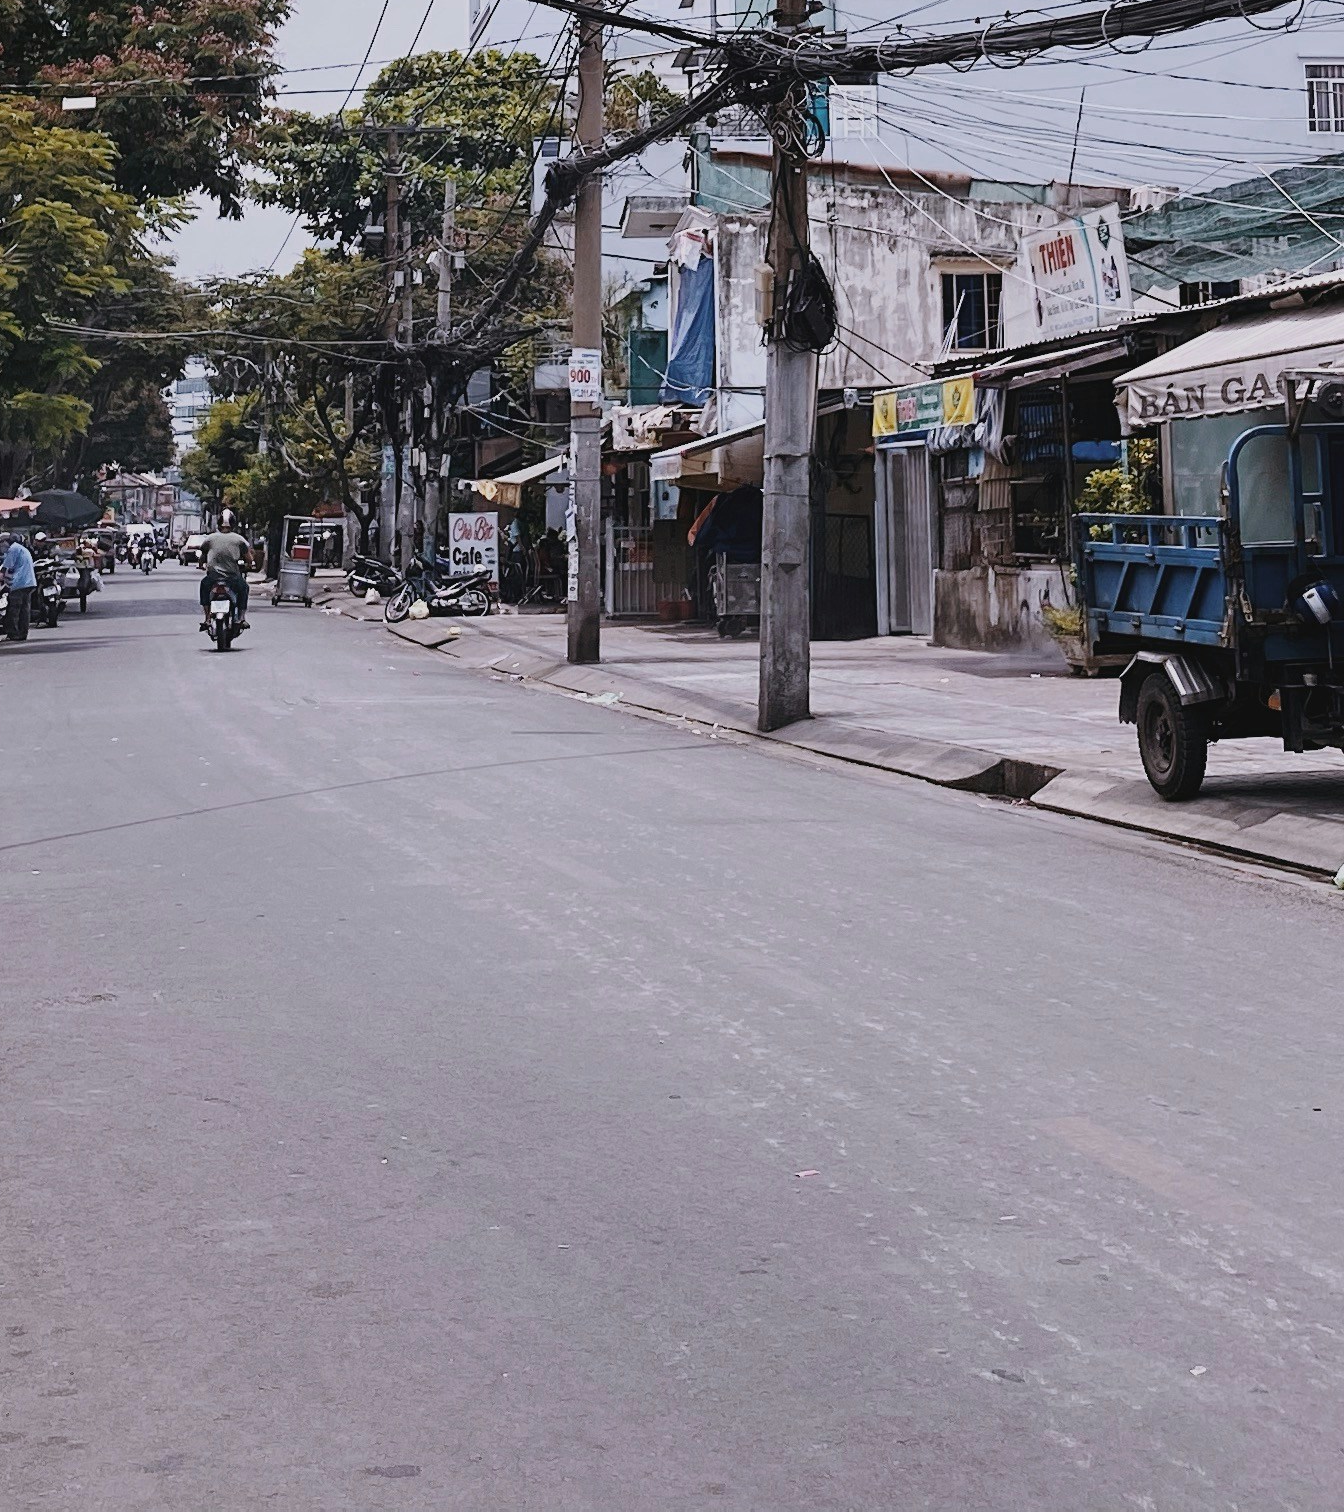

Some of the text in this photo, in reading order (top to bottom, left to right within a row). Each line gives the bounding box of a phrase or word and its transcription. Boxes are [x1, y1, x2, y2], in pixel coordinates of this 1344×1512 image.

[570, 369, 591, 383] 900
[1140, 383, 1206, 419] BÁN
[452, 546, 482, 566] Cafe
